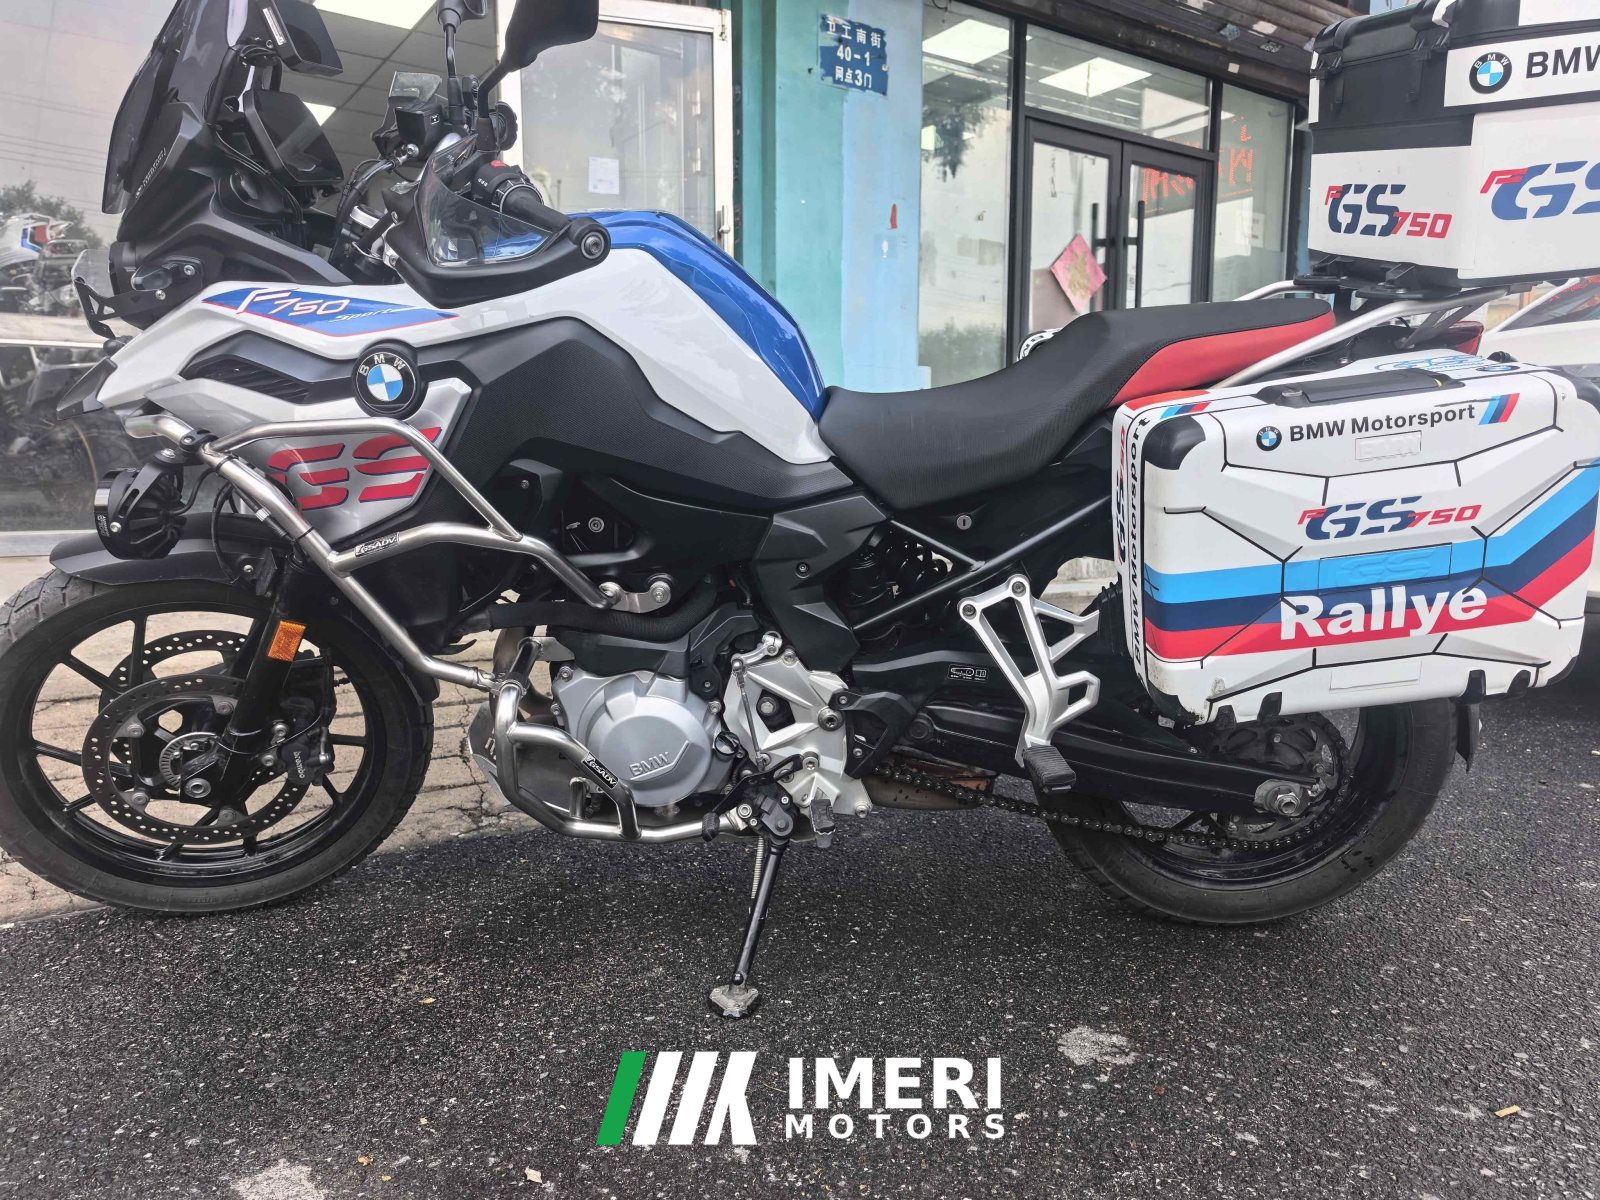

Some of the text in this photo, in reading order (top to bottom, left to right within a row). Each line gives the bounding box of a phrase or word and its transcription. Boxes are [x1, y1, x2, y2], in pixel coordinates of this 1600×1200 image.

[1289, 404, 1475, 442] BMW Motorsport
[1280, 585, 1487, 640] Rallye
[629, 751, 669, 776] BMW
